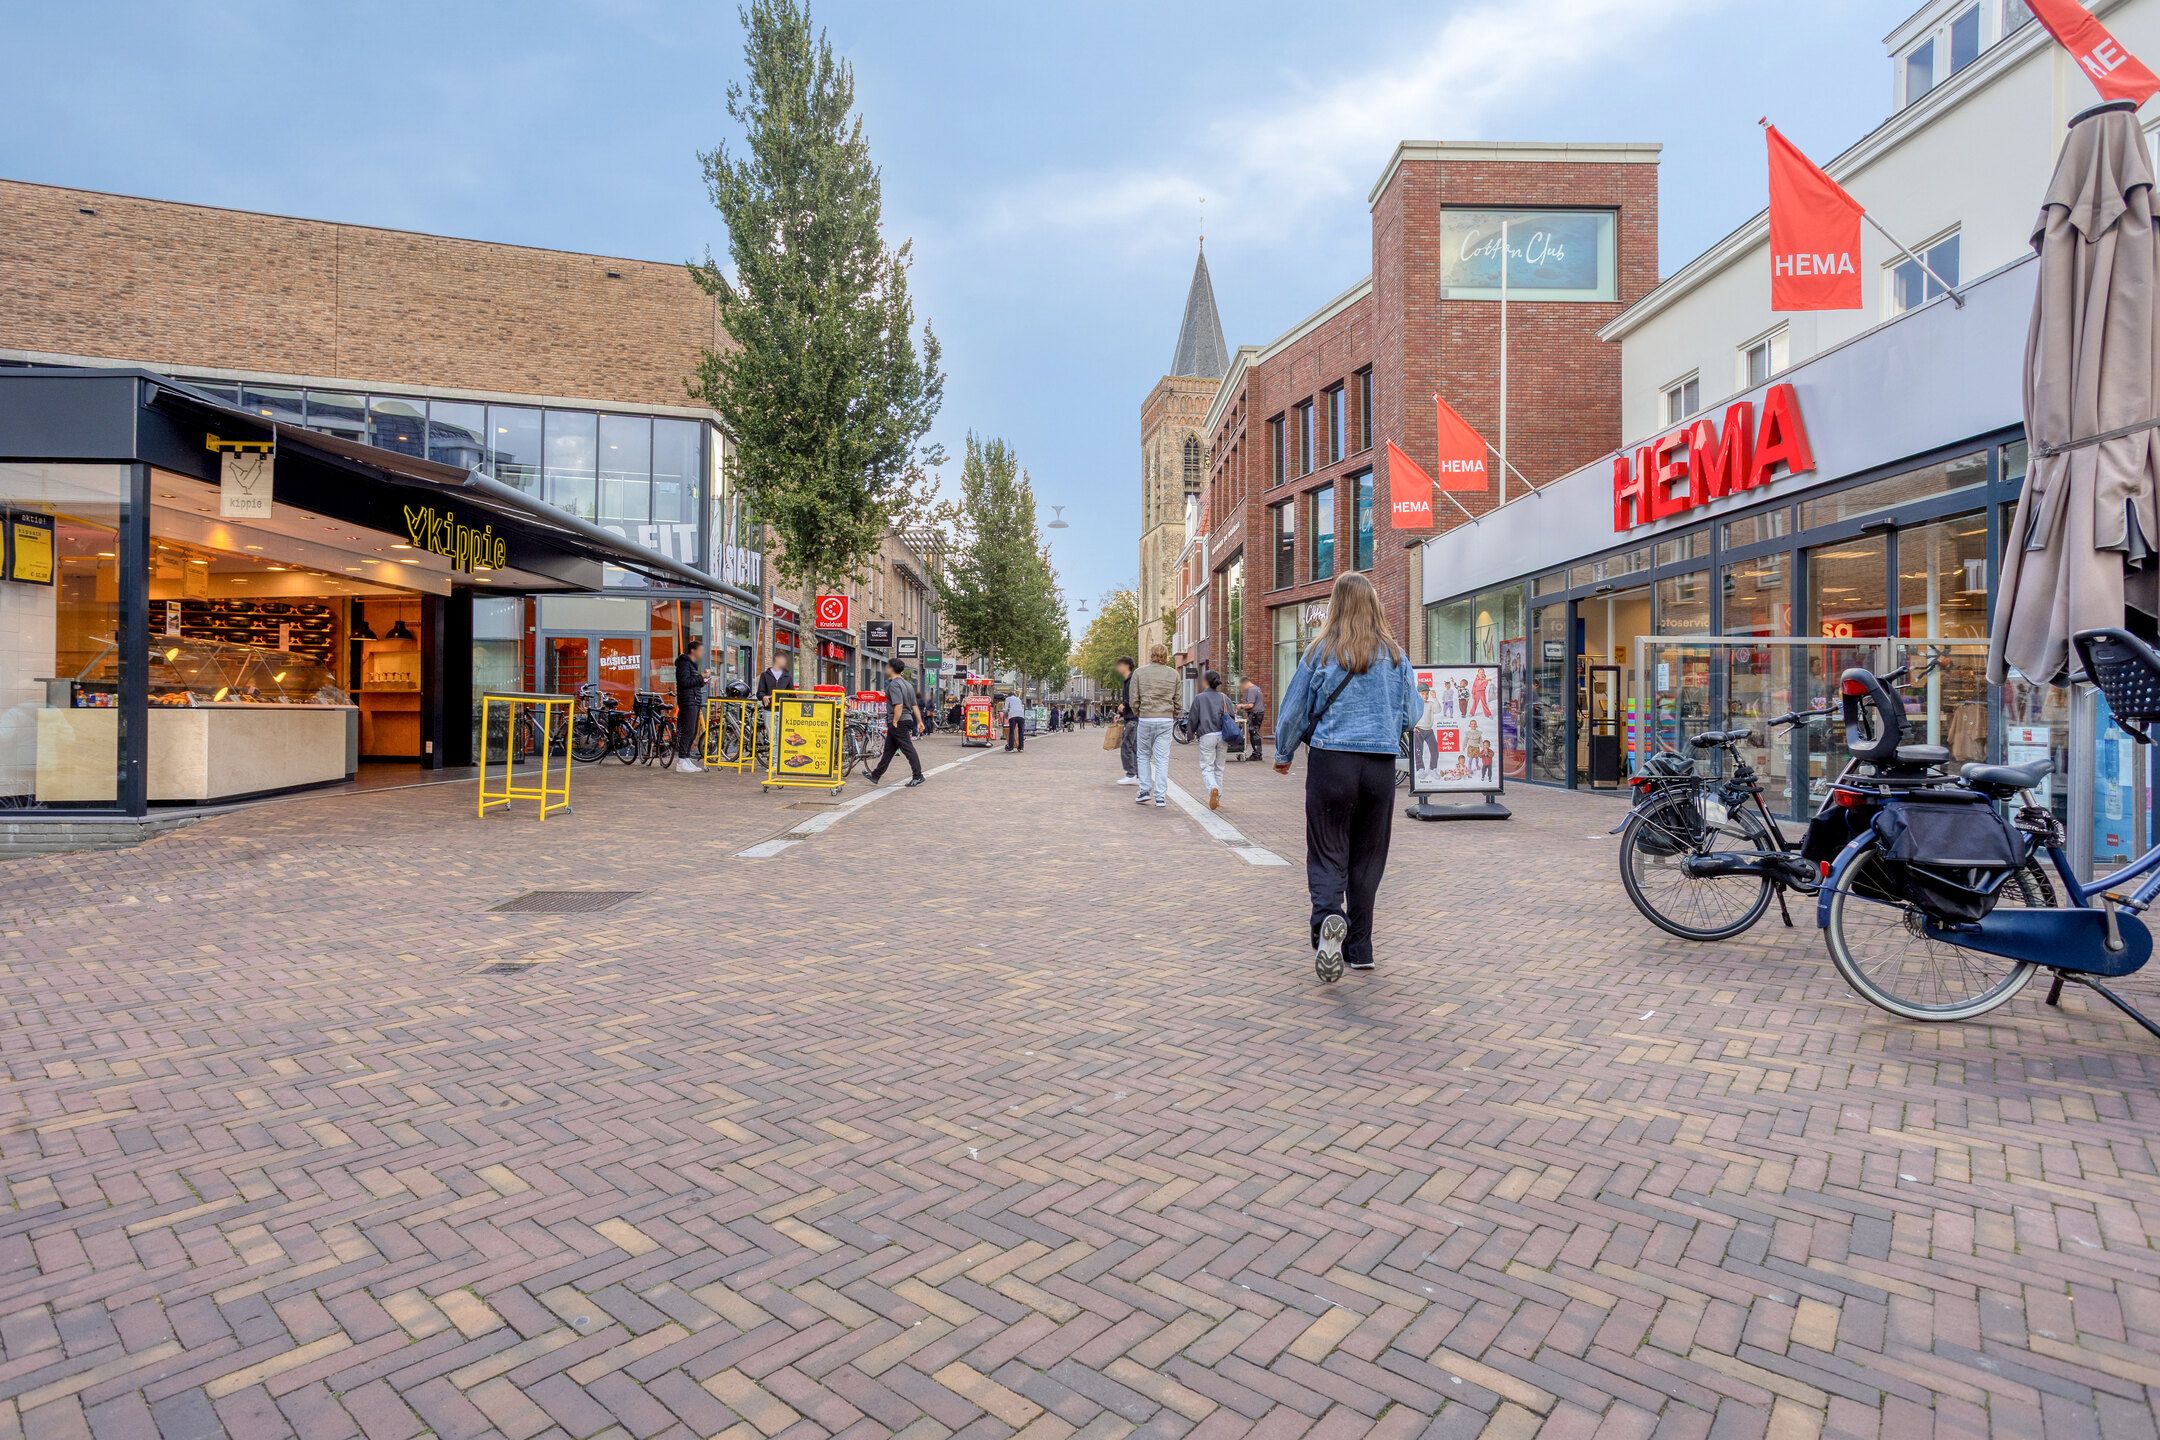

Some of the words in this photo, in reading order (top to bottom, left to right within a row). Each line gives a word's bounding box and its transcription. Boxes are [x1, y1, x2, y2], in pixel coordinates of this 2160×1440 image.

[1526, 231, 1565, 266] Club
[1775, 253, 1855, 277] HEMA
[1441, 460, 1485, 473] HEMA
[1613, 383, 1816, 533] HEMA
[231, 498, 262, 510] kippie
[1393, 501, 1430, 513] HEMA
[427, 508, 506, 574] kippie
[785, 718, 829, 727] kippenpoten
